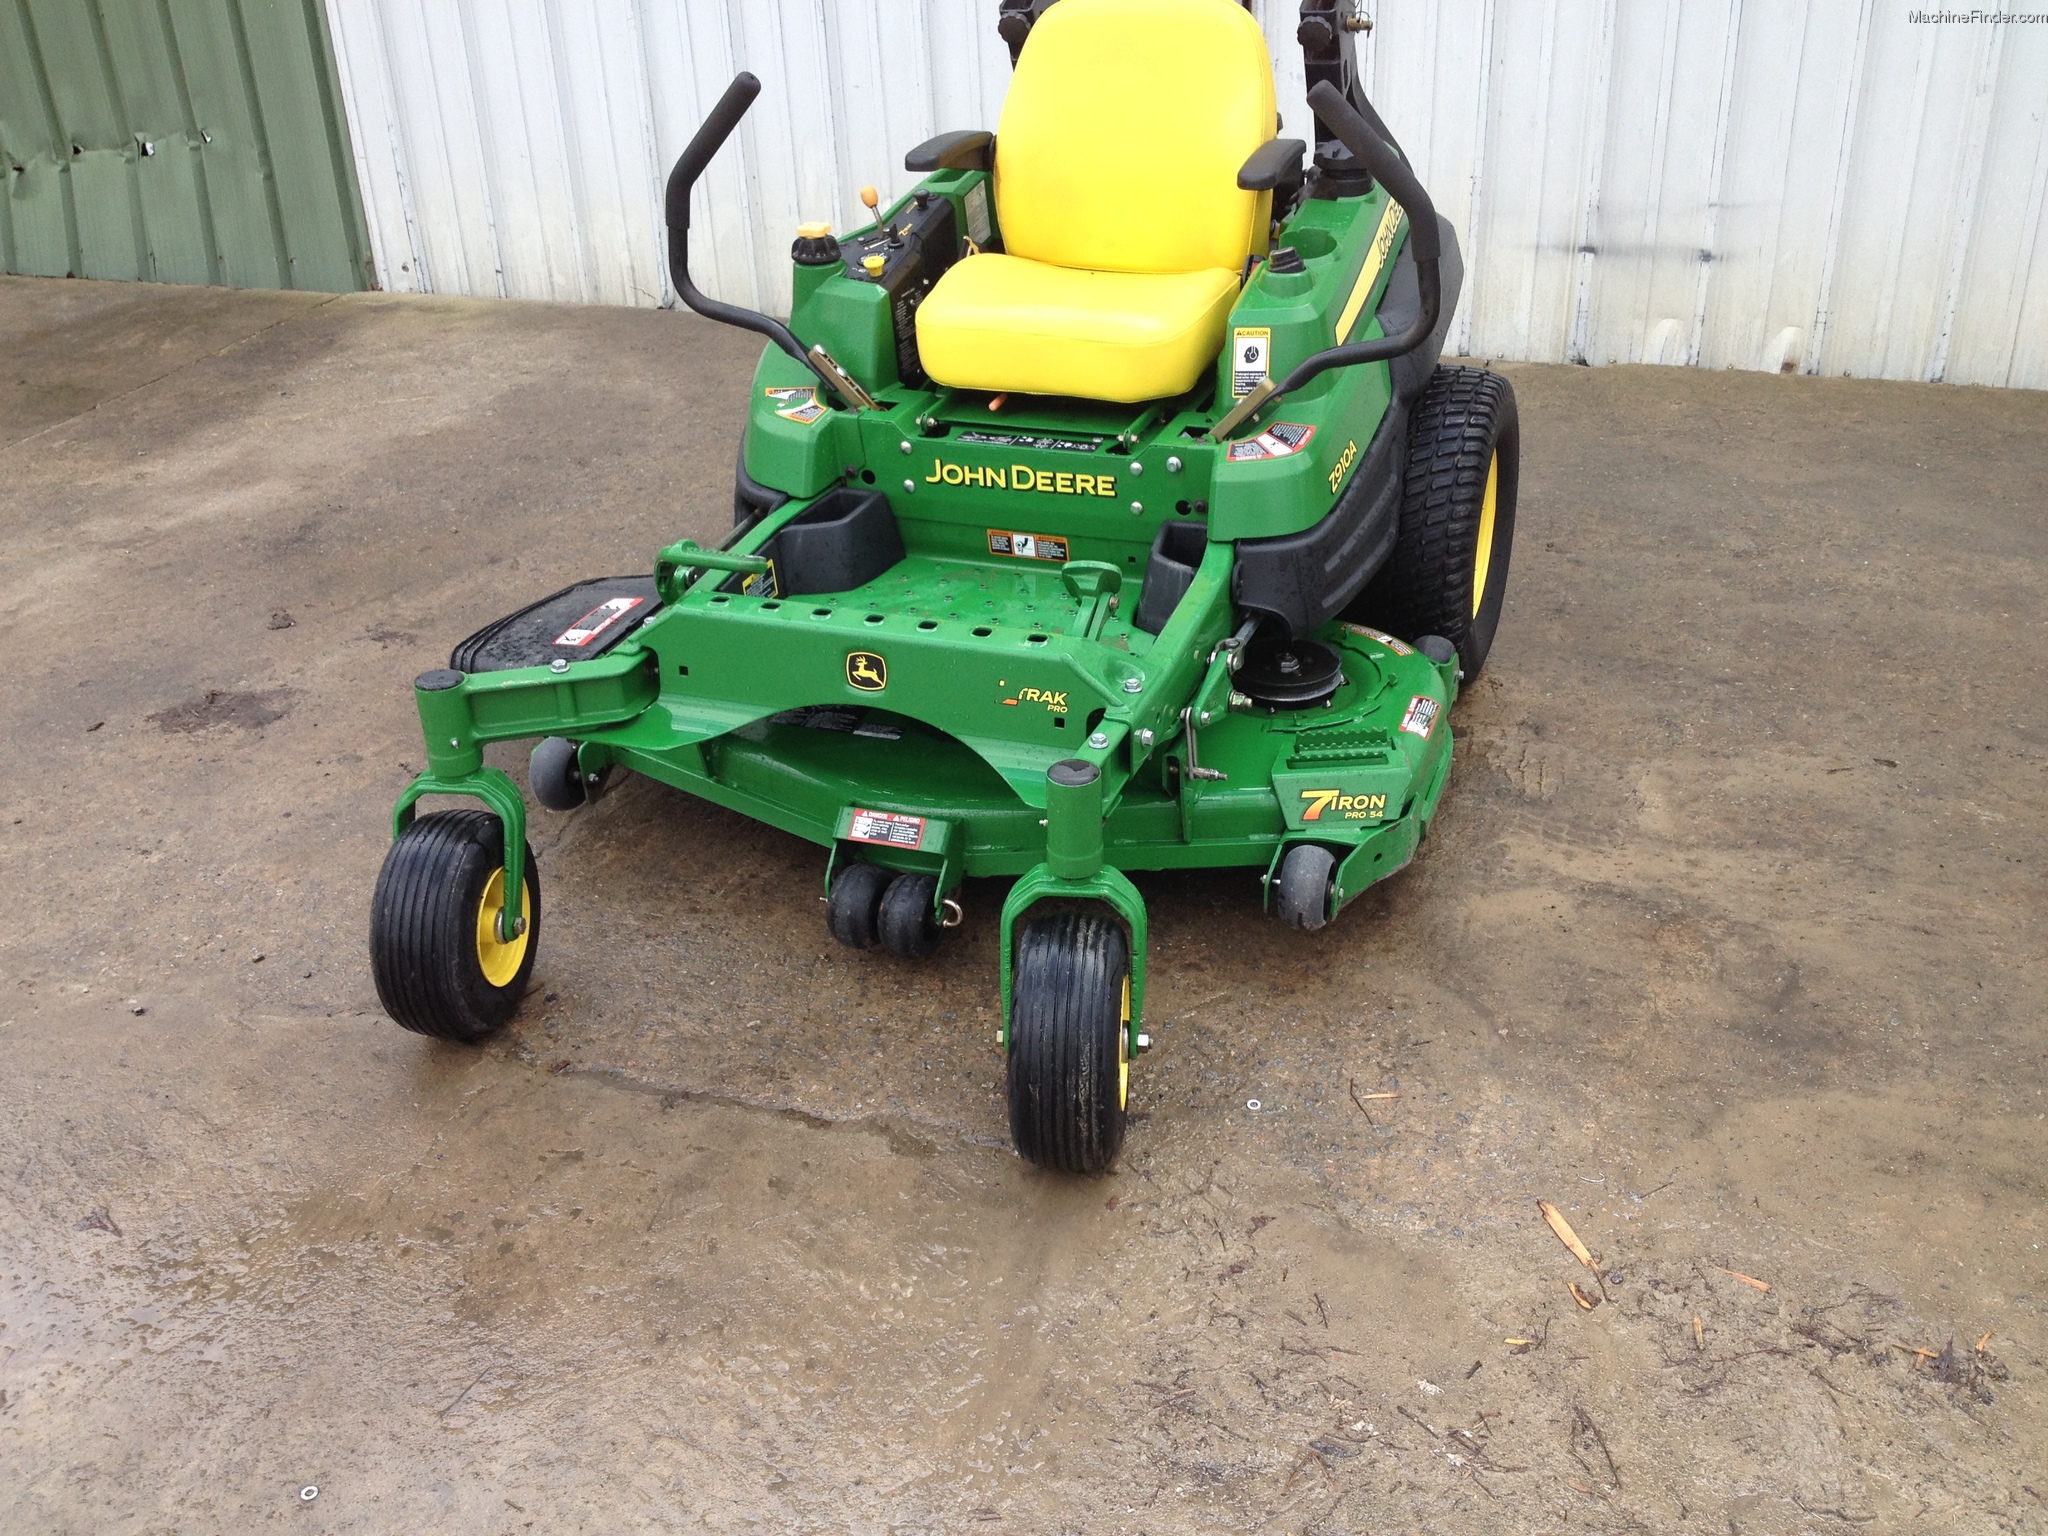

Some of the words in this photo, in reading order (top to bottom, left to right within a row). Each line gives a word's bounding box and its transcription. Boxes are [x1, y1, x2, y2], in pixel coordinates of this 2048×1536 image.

[925, 458, 1007, 490] JOHN
[1011, 464, 1118, 498] DEERE
[1328, 439, 1358, 495] Z910A
[1047, 704, 1068, 714] PRO
[1344, 811, 1367, 820] PRO
[1369, 810, 1384, 819] 54
